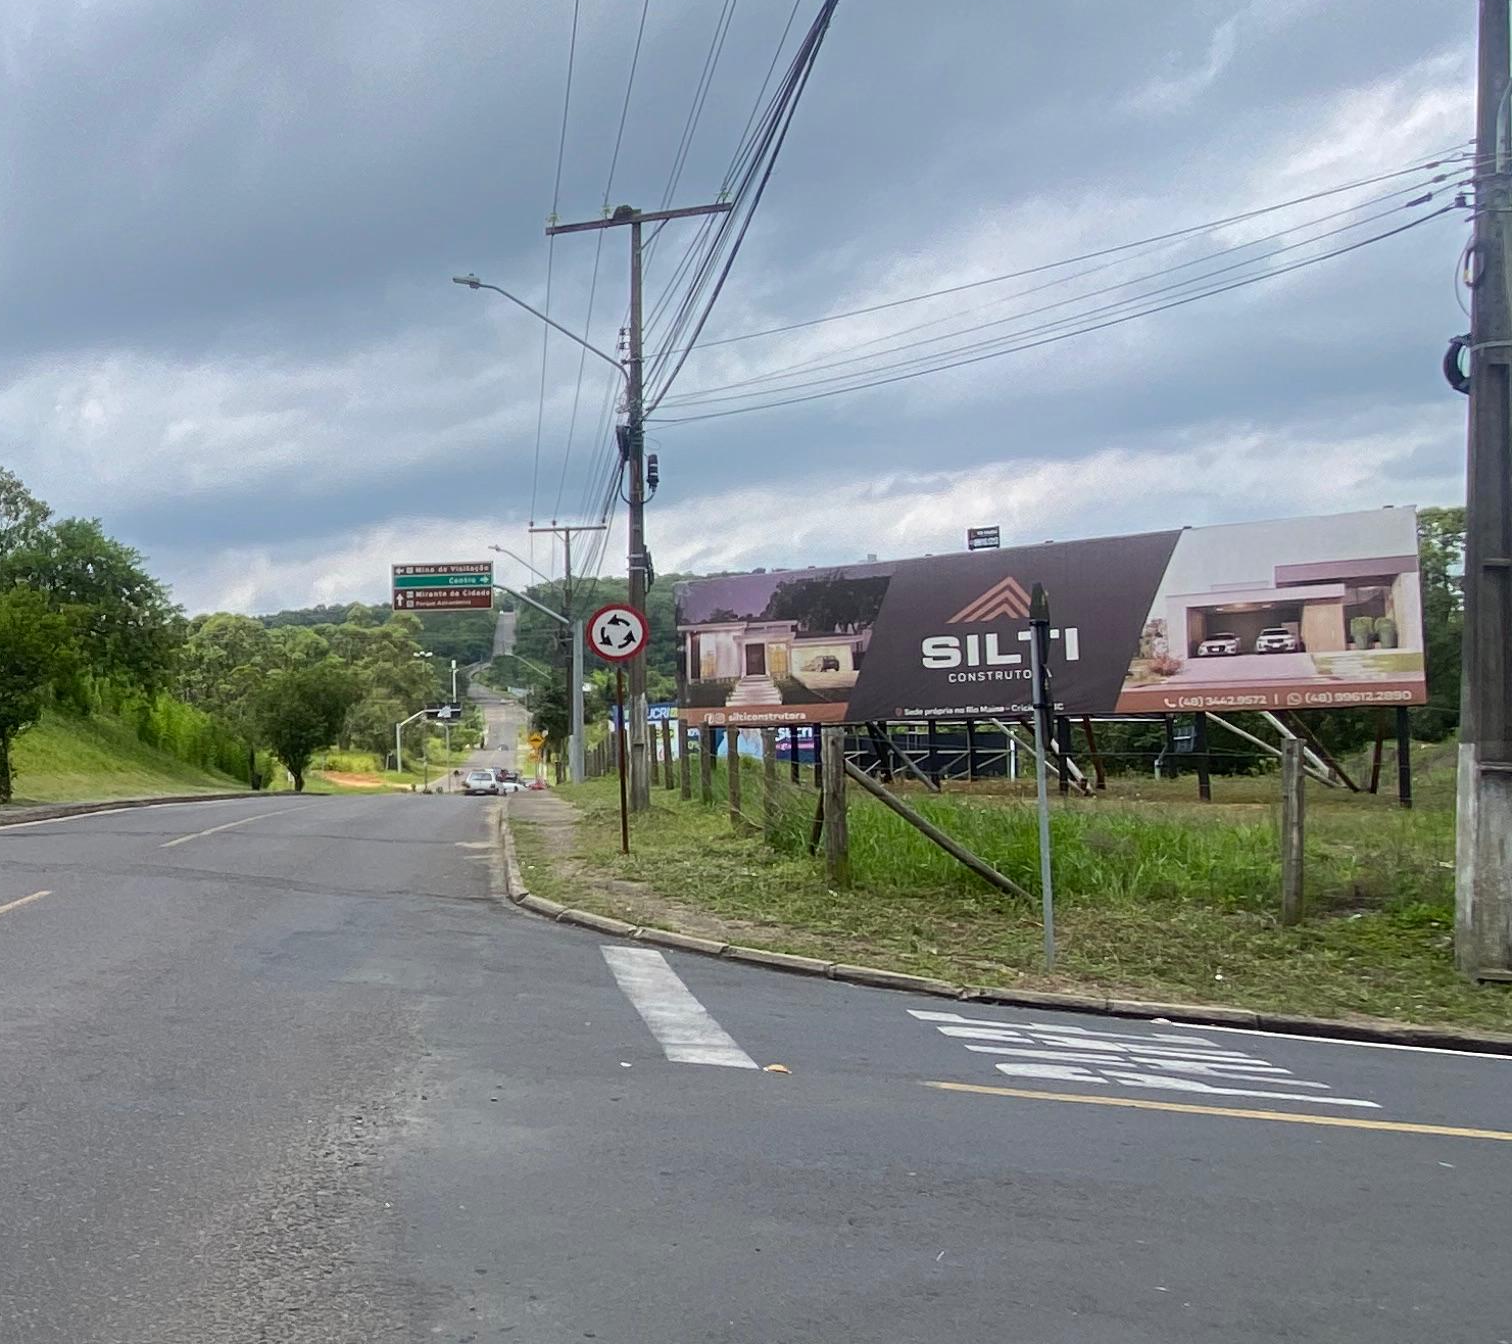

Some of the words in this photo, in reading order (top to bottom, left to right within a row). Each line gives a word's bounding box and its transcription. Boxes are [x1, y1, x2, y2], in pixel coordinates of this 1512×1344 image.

[948, 669, 1053, 683] CONSTRUTO
[1178, 696, 1204, 707] (48)
[1305, 692, 1332, 703] (48)
[728, 712, 807, 722] silticonstrutora
[966, 706, 979, 714] Rio
[906, 1009, 1384, 1108] PARE
